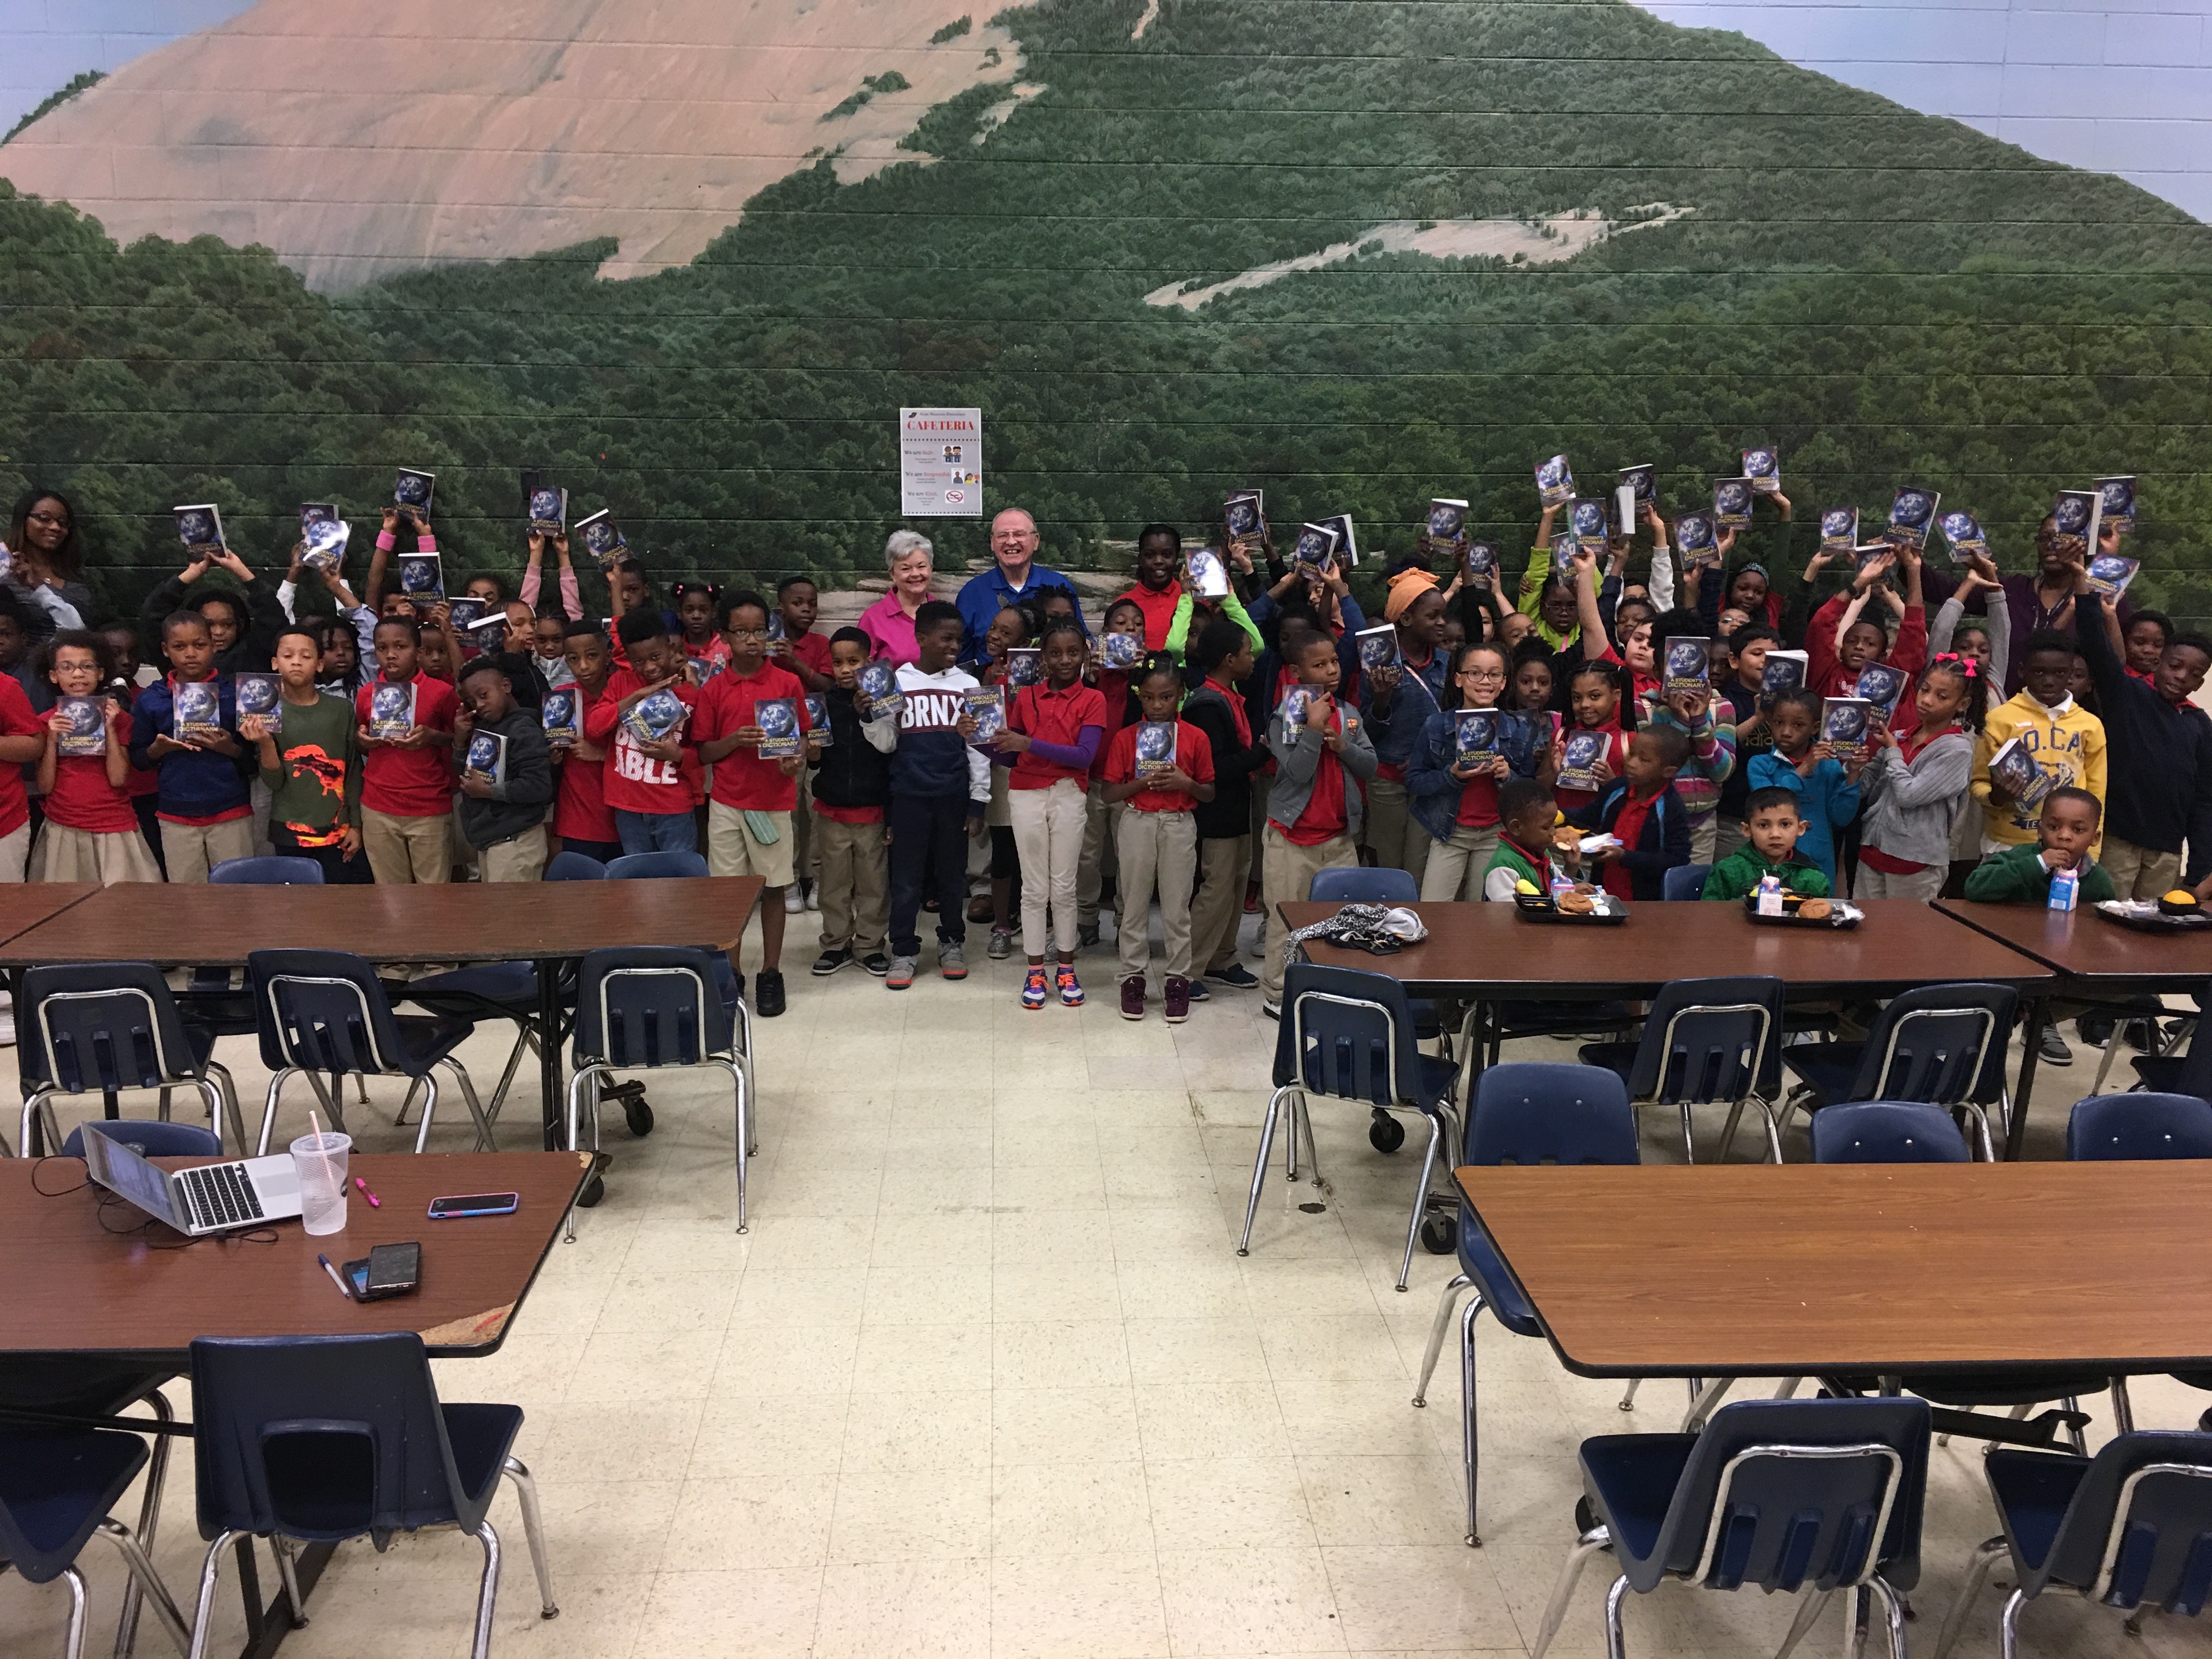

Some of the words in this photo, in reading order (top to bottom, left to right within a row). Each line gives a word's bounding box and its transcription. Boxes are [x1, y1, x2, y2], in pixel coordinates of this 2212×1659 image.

[907, 420, 974, 430] CAFETERIA
[966, 694, 999, 702] DICTIONARY
[901, 695, 965, 729] BRNX
[614, 746, 678, 785] ABLE
[1560, 771, 1595, 780] DICTIONARY
